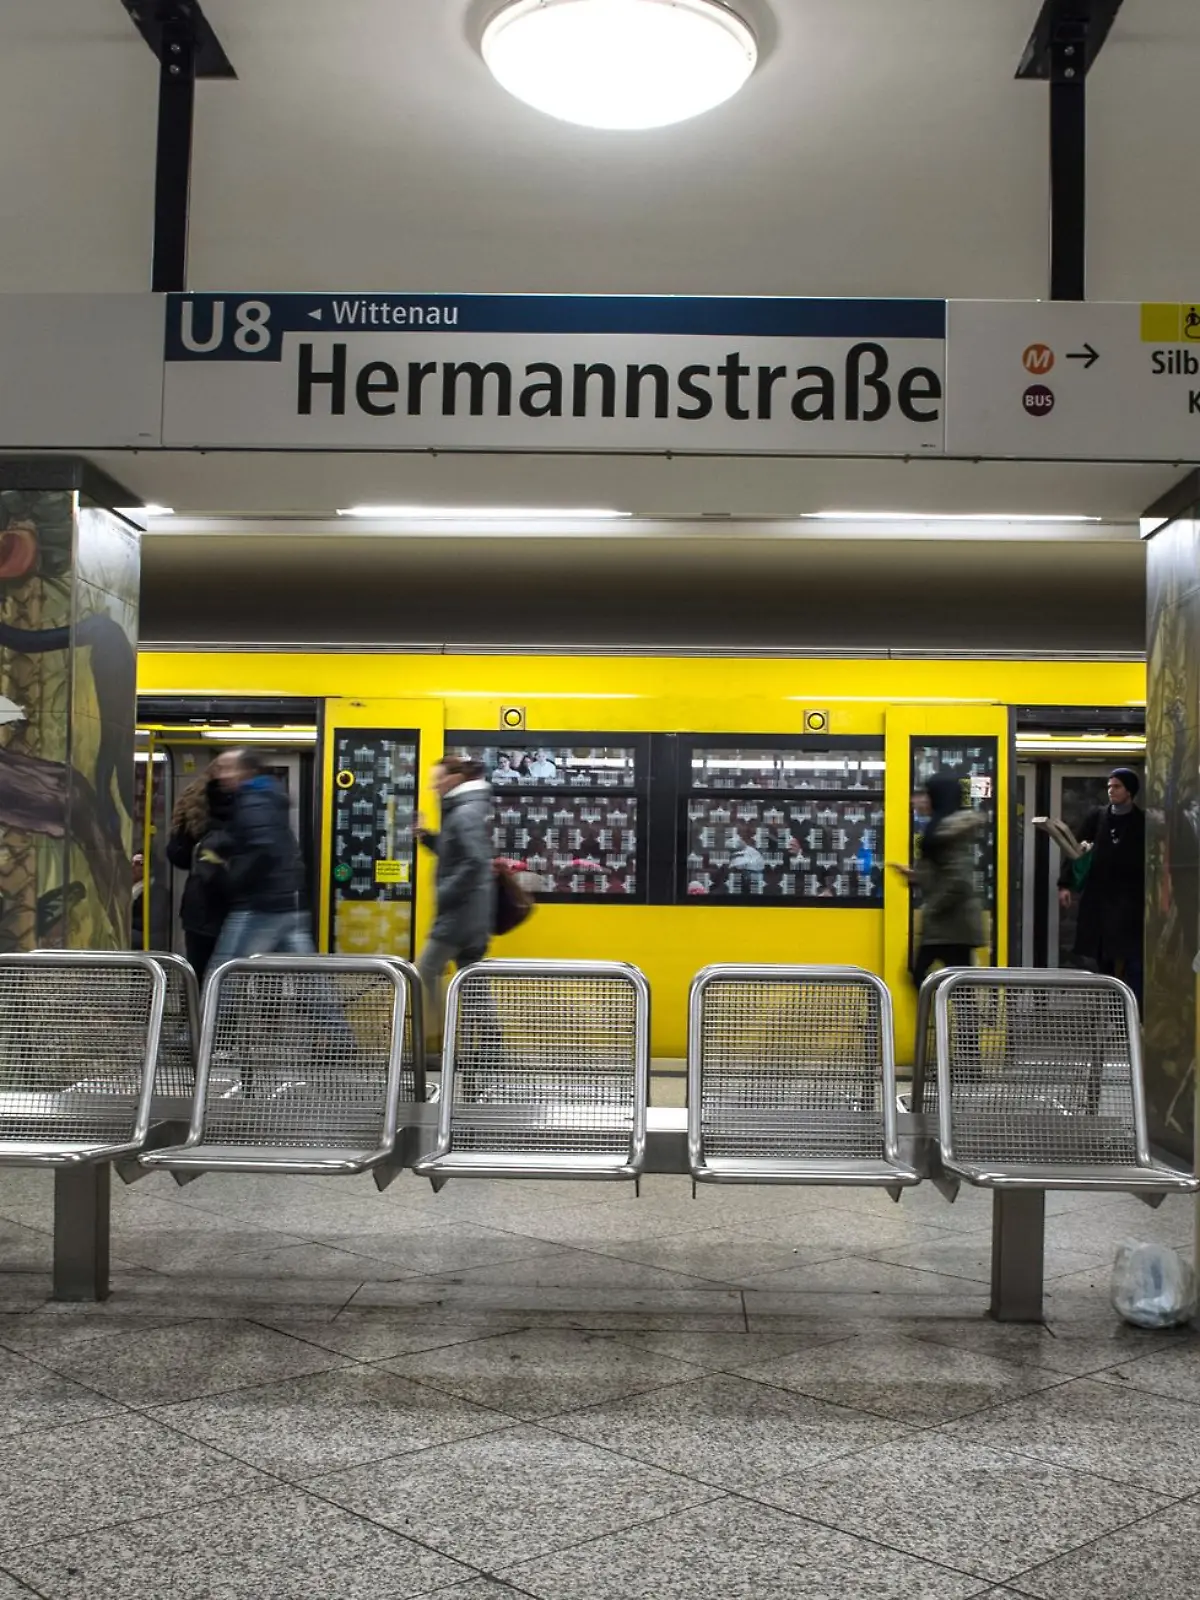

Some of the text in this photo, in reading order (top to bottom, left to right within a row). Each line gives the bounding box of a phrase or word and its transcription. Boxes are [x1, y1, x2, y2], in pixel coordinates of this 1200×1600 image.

[332, 300, 459, 325] Wittenau
[180, 300, 272, 353] U8
[1026, 349, 1051, 369] M
[1151, 349, 1200, 375] Silb
[297, 342, 942, 422] Hermannstraße
[1025, 395, 1052, 407] BUS
